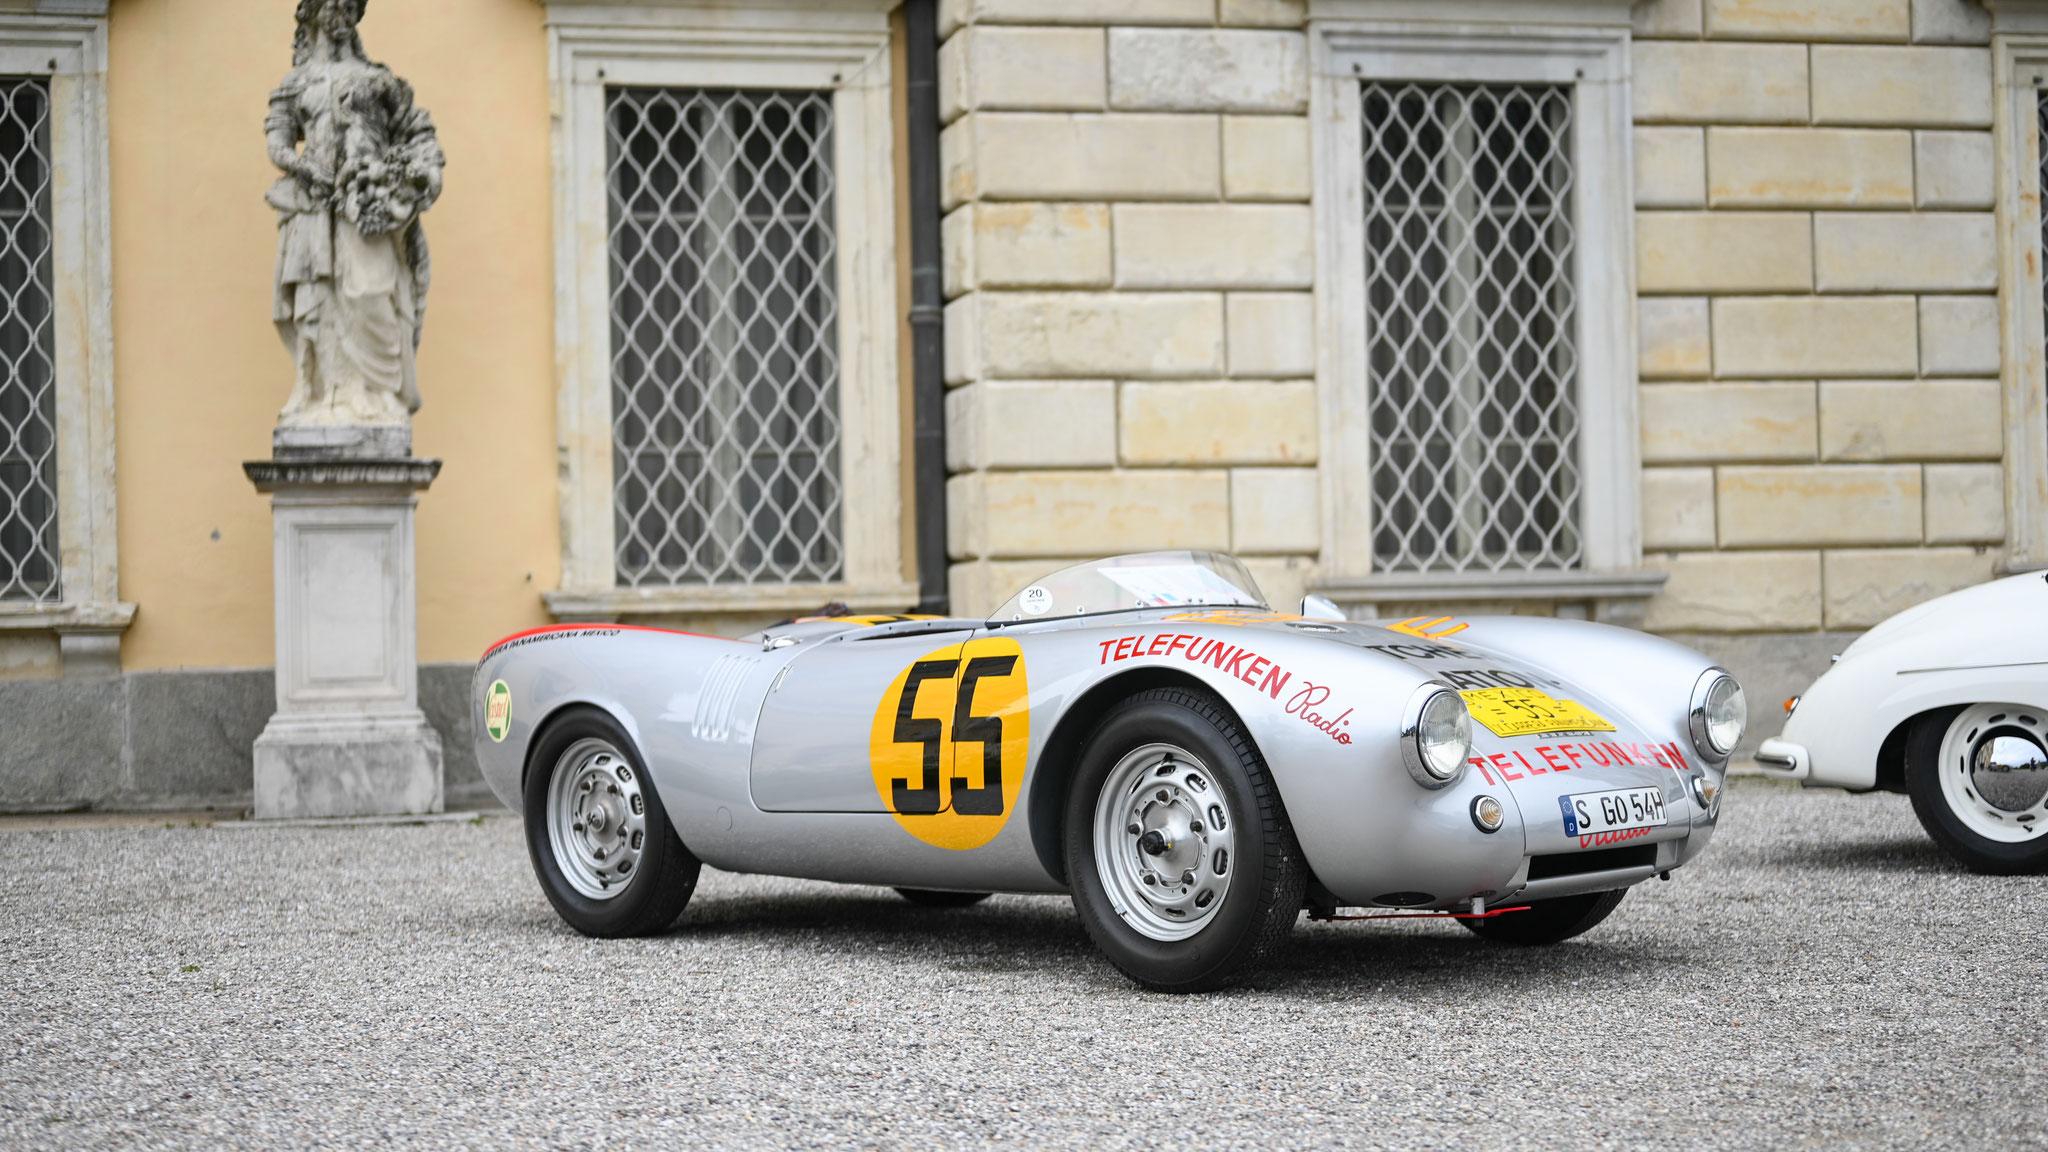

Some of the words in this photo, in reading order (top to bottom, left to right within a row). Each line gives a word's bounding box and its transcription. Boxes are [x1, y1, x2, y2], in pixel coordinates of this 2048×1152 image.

[1028, 588, 1043, 598] 20
[509, 630, 578, 650] PANAMERICANA
[580, 629, 620, 637] MEXICO
[1099, 634, 1292, 700] TELEFUNKEN
[1285, 681, 1354, 745] Radio
[1503, 699, 1555, 719] 55
[891, 655, 1019, 816] 55
[1468, 741, 1689, 786] TELEFUNKEN
[1575, 799, 1591, 829] S
[1600, 795, 1628, 826] GO
[1629, 791, 1666, 821] 54H
[1569, 822, 1575, 832] D
